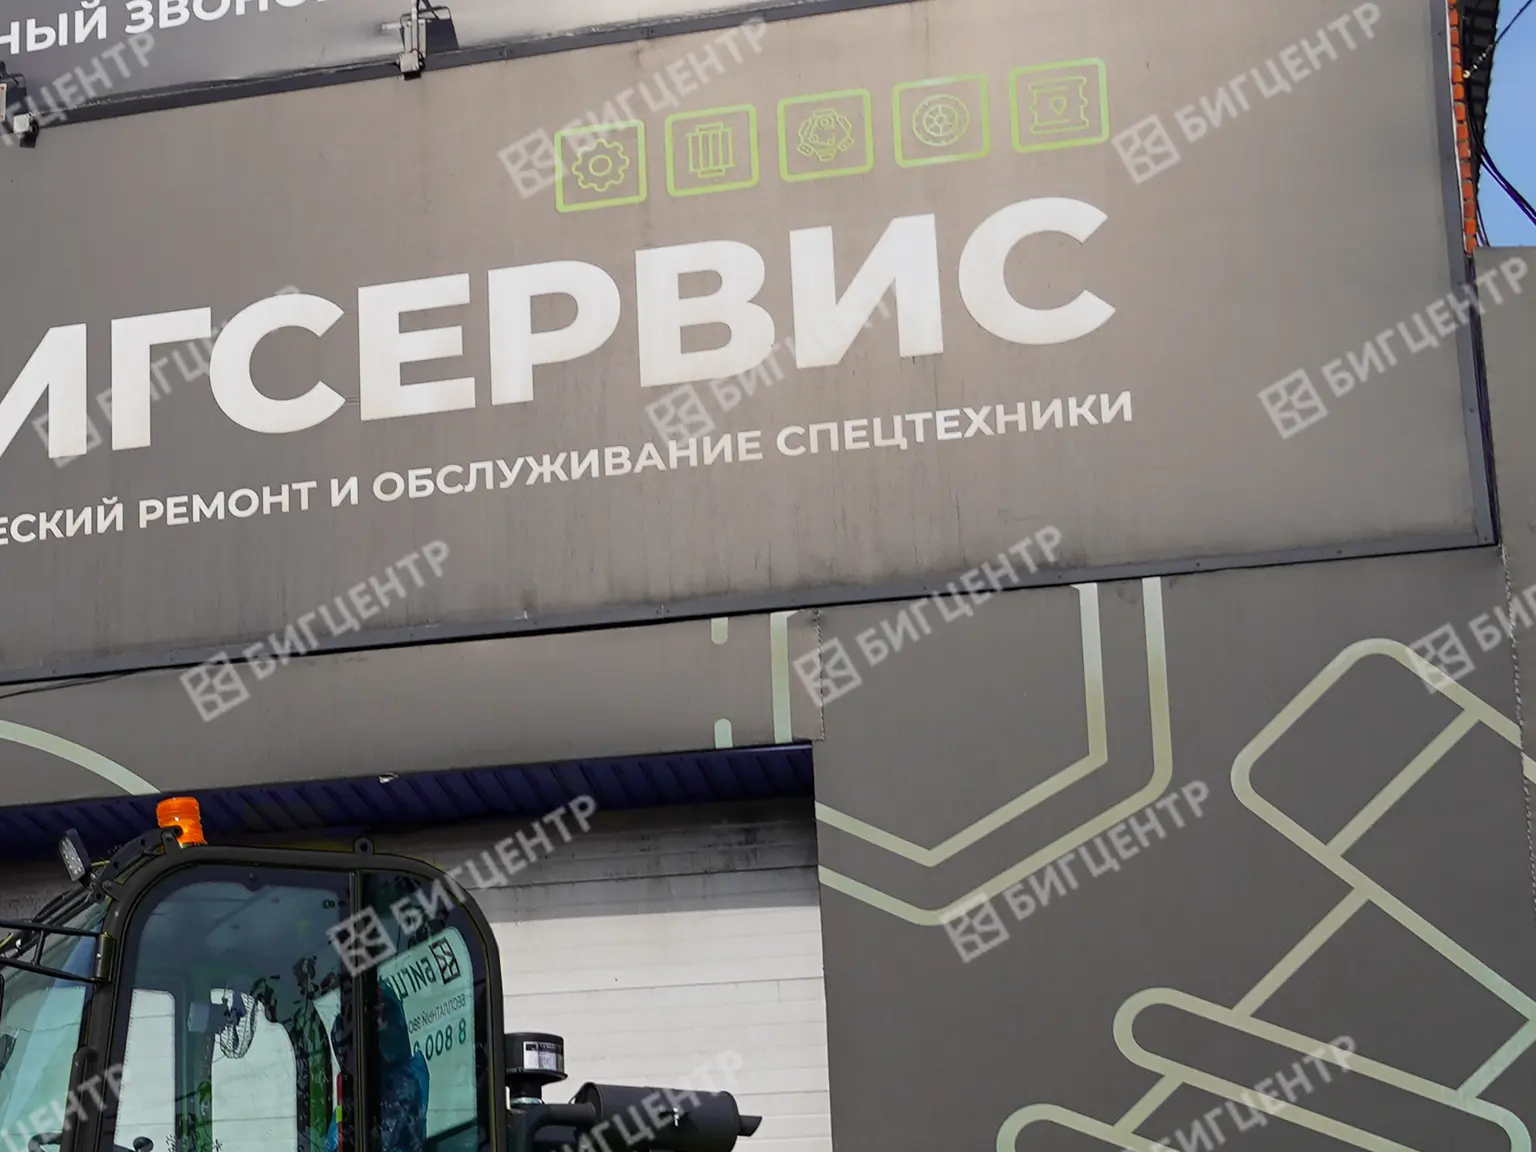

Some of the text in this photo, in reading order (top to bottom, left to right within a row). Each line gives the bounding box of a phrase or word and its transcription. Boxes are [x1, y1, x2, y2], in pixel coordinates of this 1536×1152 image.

[125, 0, 325, 33] ЗВО
[138, 480, 317, 525] РЕМОНТ
[330, 477, 360, 508] И
[372, 430, 763, 502] ОБСЛУЖИВАНИЕ
[776, 390, 1133, 458] СПЕЦТЕХНИКИ
